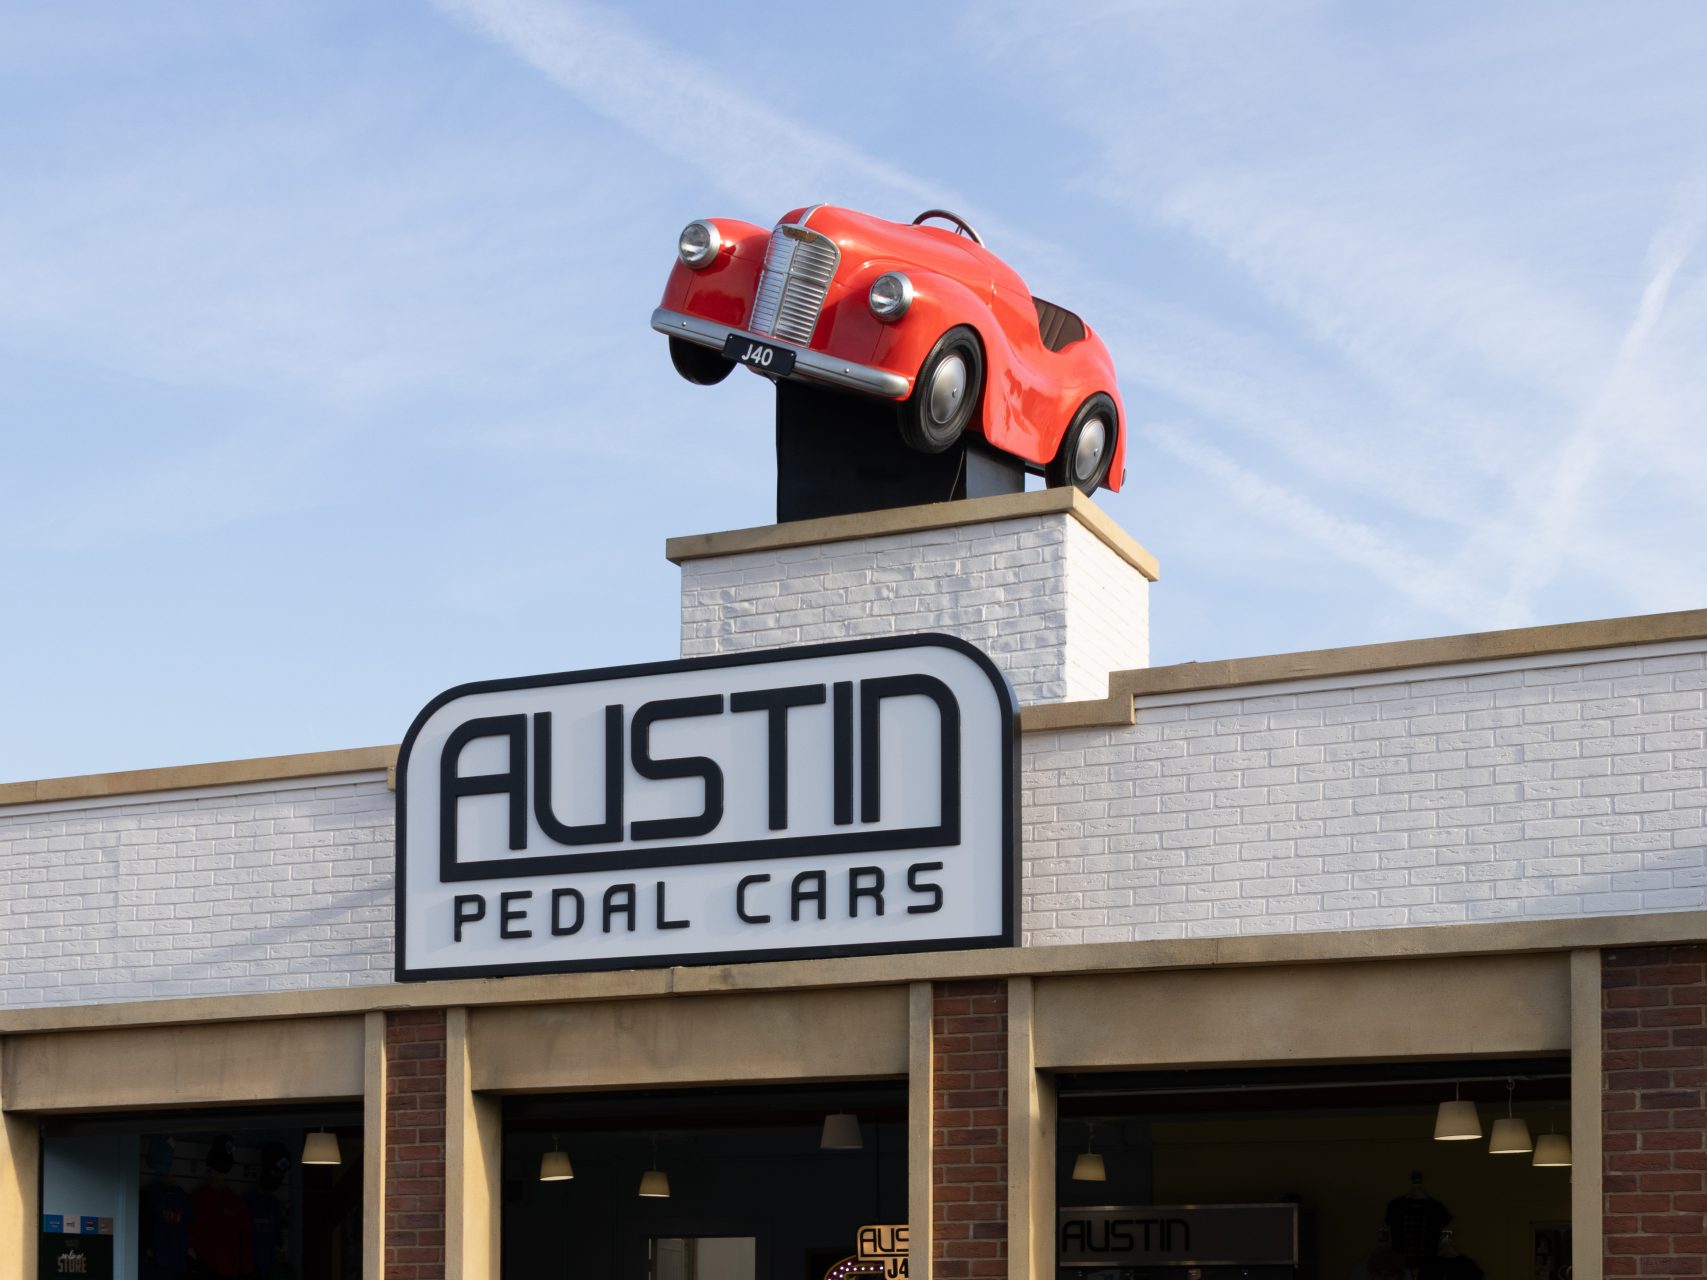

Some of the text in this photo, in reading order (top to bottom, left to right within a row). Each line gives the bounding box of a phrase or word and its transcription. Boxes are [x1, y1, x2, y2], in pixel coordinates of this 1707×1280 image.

[741, 343, 773, 366] J40
[440, 673, 961, 883] AUSTIN
[454, 861, 944, 942] PEDAL CARS
[1062, 1218, 1190, 1252] AUSTIN
